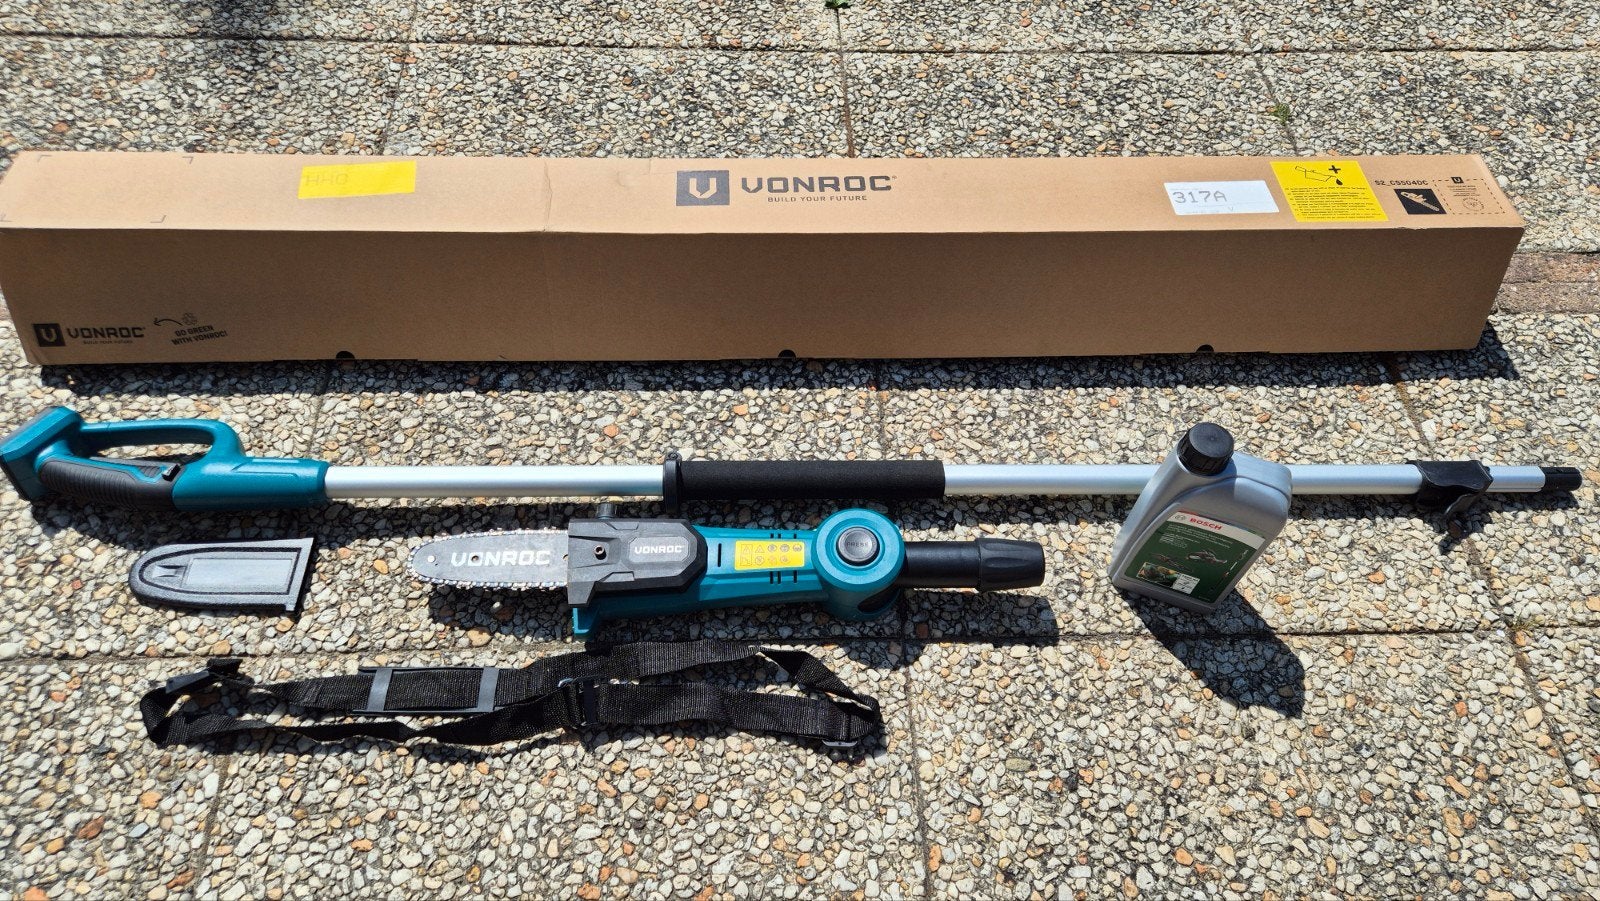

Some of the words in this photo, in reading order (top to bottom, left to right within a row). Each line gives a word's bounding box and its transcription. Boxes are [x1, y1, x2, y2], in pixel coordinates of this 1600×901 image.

[741, 175, 892, 193] VONROC
[1172, 190, 1228, 204] 317A
[66, 326, 145, 339] VONROC
[187, 325, 215, 335] GREEN
[171, 336, 193, 345] WITH
[192, 330, 228, 342] VONROC!
[1189, 518, 1222, 530] BOSCH
[634, 545, 683, 554] VONROC
[450, 550, 551, 567] VONROC
